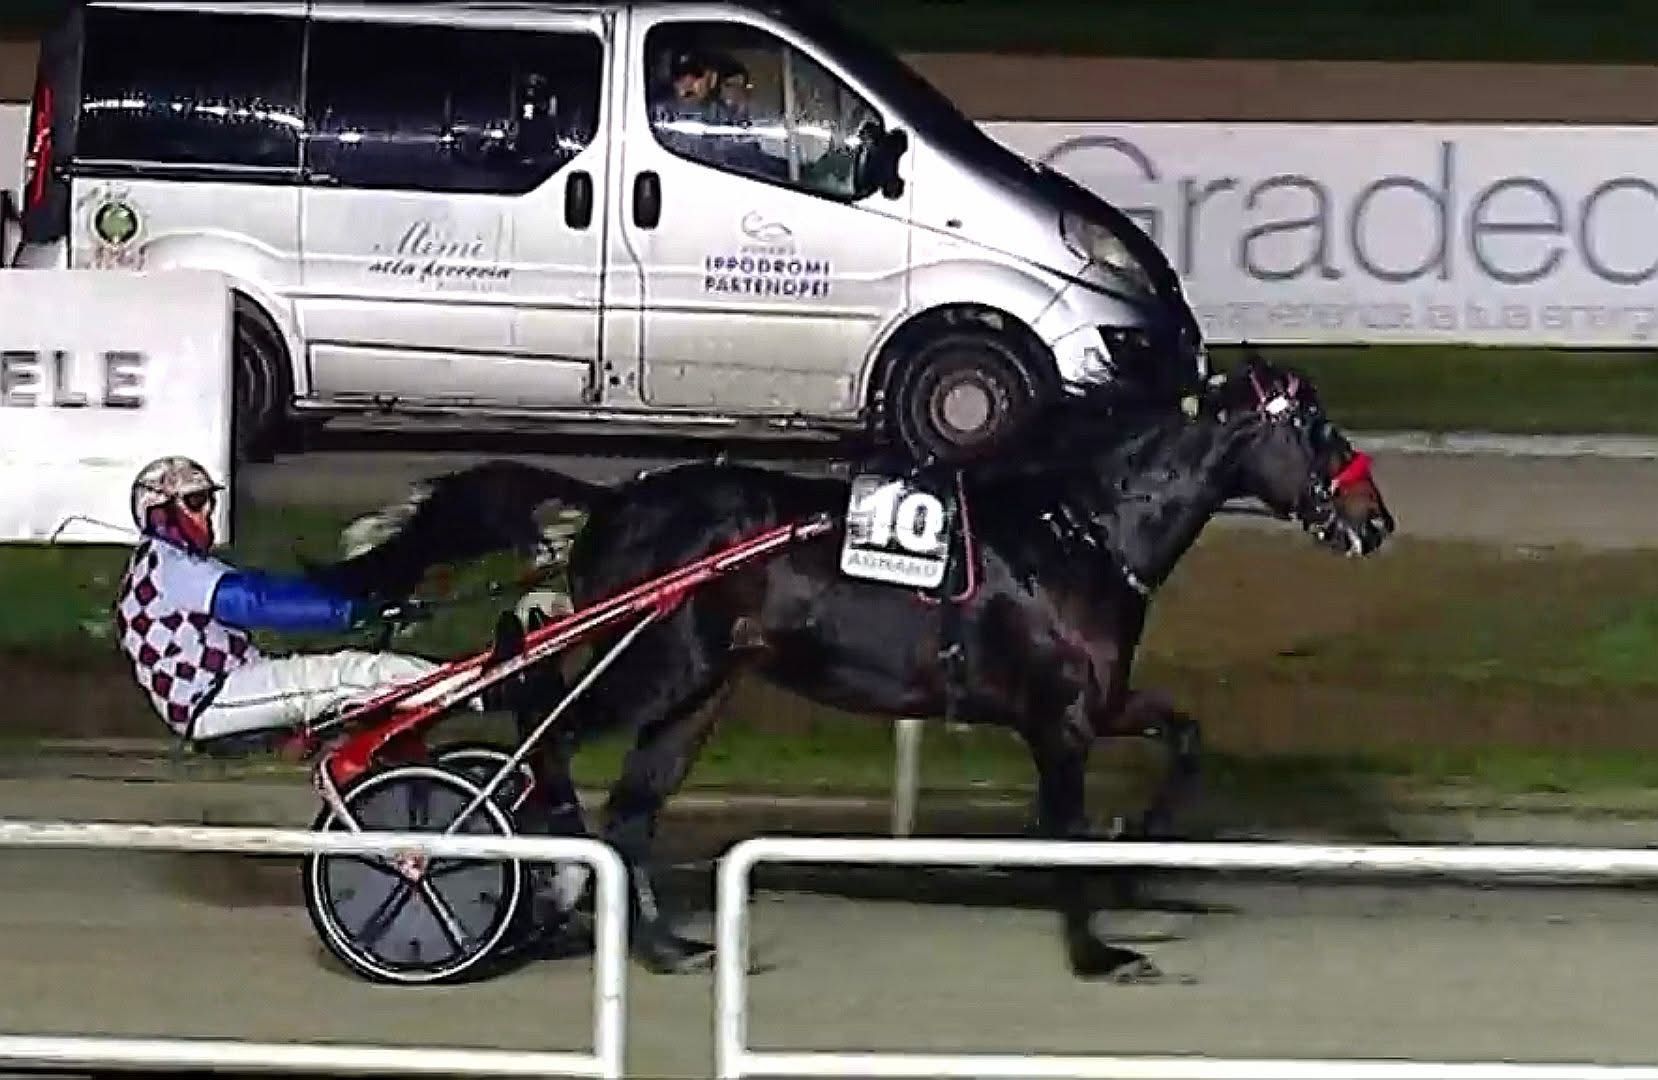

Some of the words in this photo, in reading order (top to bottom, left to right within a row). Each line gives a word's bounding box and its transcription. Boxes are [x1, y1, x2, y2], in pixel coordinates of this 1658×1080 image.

[1045, 134, 1658, 284] Grade
[705, 255, 830, 276] IPPODROMI
[0, 349, 144, 408] ELE
[857, 479, 944, 552] 10
